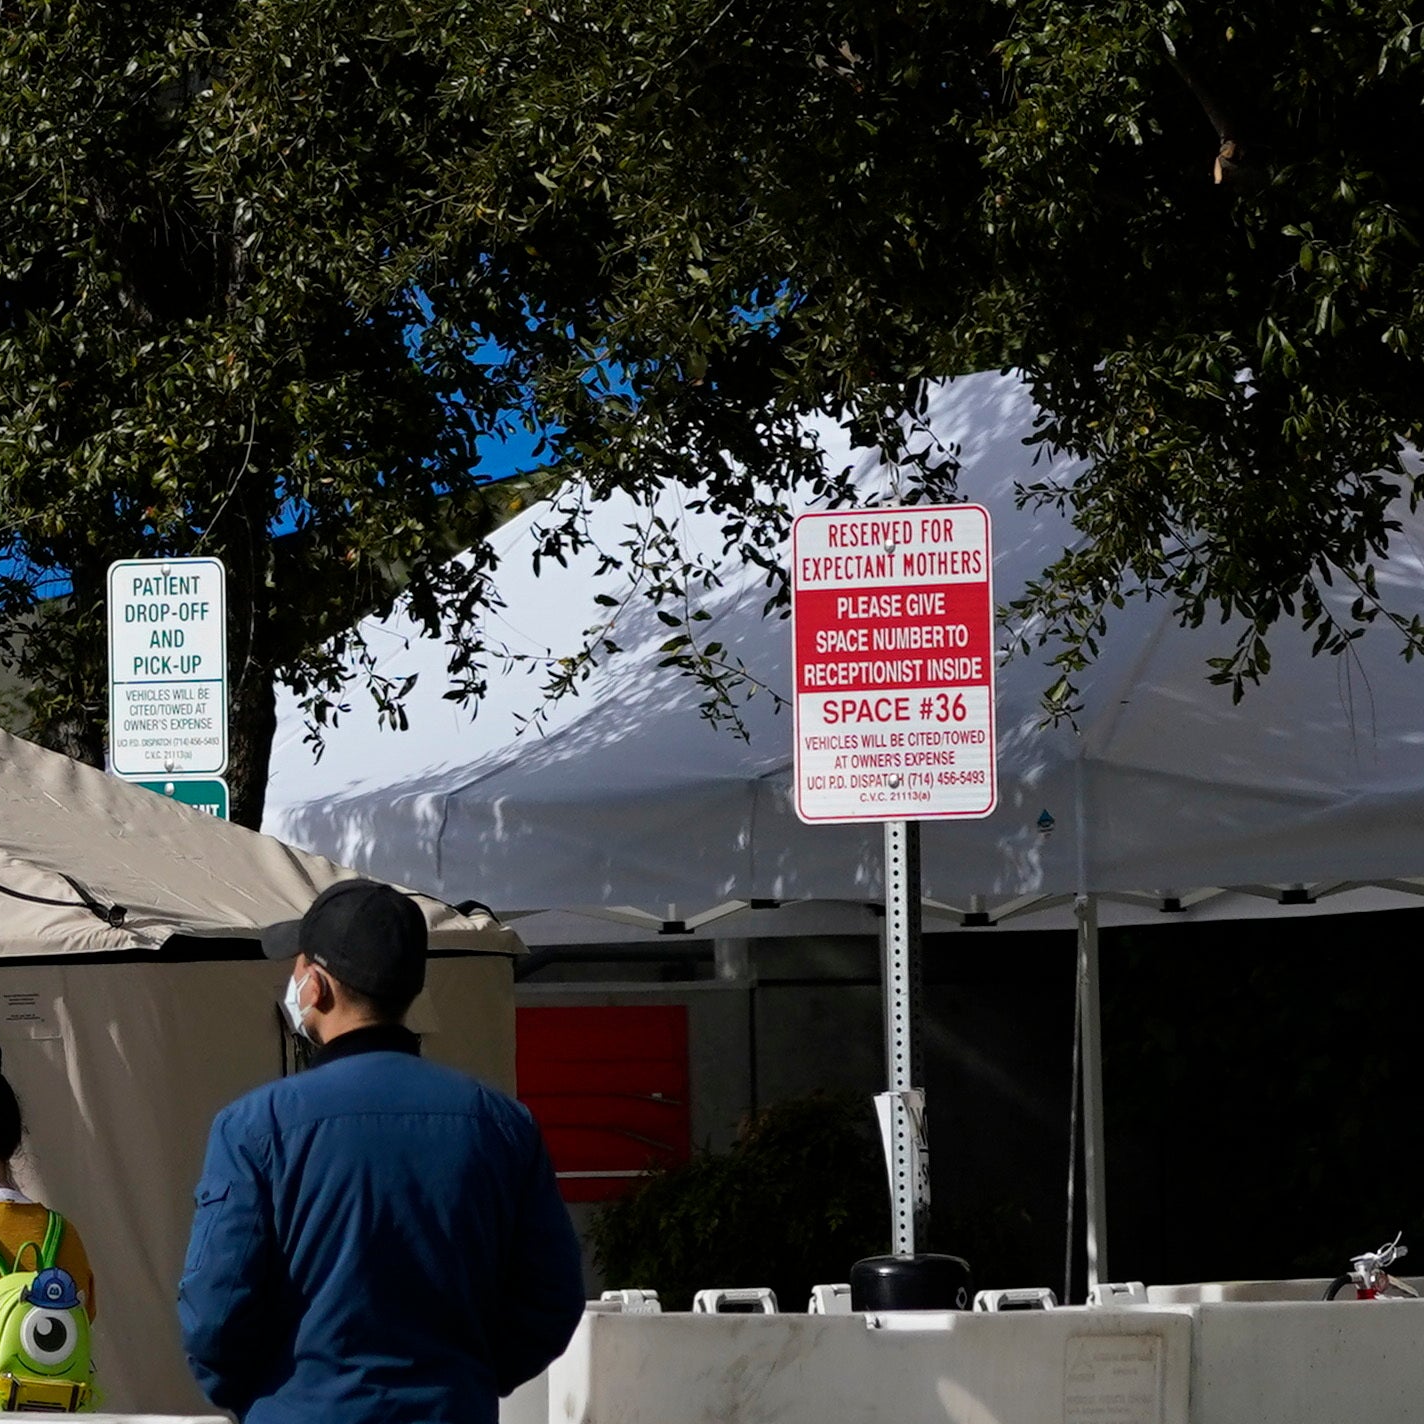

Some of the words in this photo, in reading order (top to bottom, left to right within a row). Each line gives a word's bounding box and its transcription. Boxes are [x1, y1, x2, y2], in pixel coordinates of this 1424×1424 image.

[828, 520, 912, 548] RESERVED
[921, 519, 953, 543] FOR
[802, 553, 895, 581] EXPECTANT
[903, 550, 981, 577] MOTHERS
[133, 576, 200, 597] PATIENT
[125, 602, 209, 623] DROP-OFF
[837, 594, 901, 619] PLEASE
[906, 593, 945, 615] GIVE
[150, 629, 184, 648] AND
[816, 629, 868, 653] SPACE
[872, 625, 947, 651] NUMBER
[947, 624, 968, 648] TO
[133, 655, 202, 676] PICK-UP
[804, 659, 923, 687] RECEPTIONIST
[927, 657, 982, 682] INSIDE
[126, 688, 171, 701] VEHICLES
[172, 688, 195, 700] WILL
[197, 687, 210, 700] BE
[129, 703, 193, 716] CITED/TOWED
[195, 703, 207, 715] AT
[823, 698, 910, 724] SPACE
[920, 693, 967, 723] #36
[124, 719, 168, 731] OWNER'S
[170, 718, 213, 730] EXPENSE
[805, 735, 858, 750] VEHICLES
[861, 734, 887, 748] WILL
[890, 733, 905, 747] BE
[907, 730, 985, 746] CITED/TOWED
[834, 755, 848, 770] AT
[852, 753, 901, 768] OWNER'S
[904, 751, 955, 766] EXPENSE
[807, 776, 826, 790] UCI
[829, 775, 847, 789] P.D.
[850, 773, 904, 789] DISPATH
[908, 772, 934, 790] (714)
[937, 770, 985, 786] 456-5493
[860, 792, 887, 803] C.V.C.
[890, 791, 931, 802] 21113(a)
